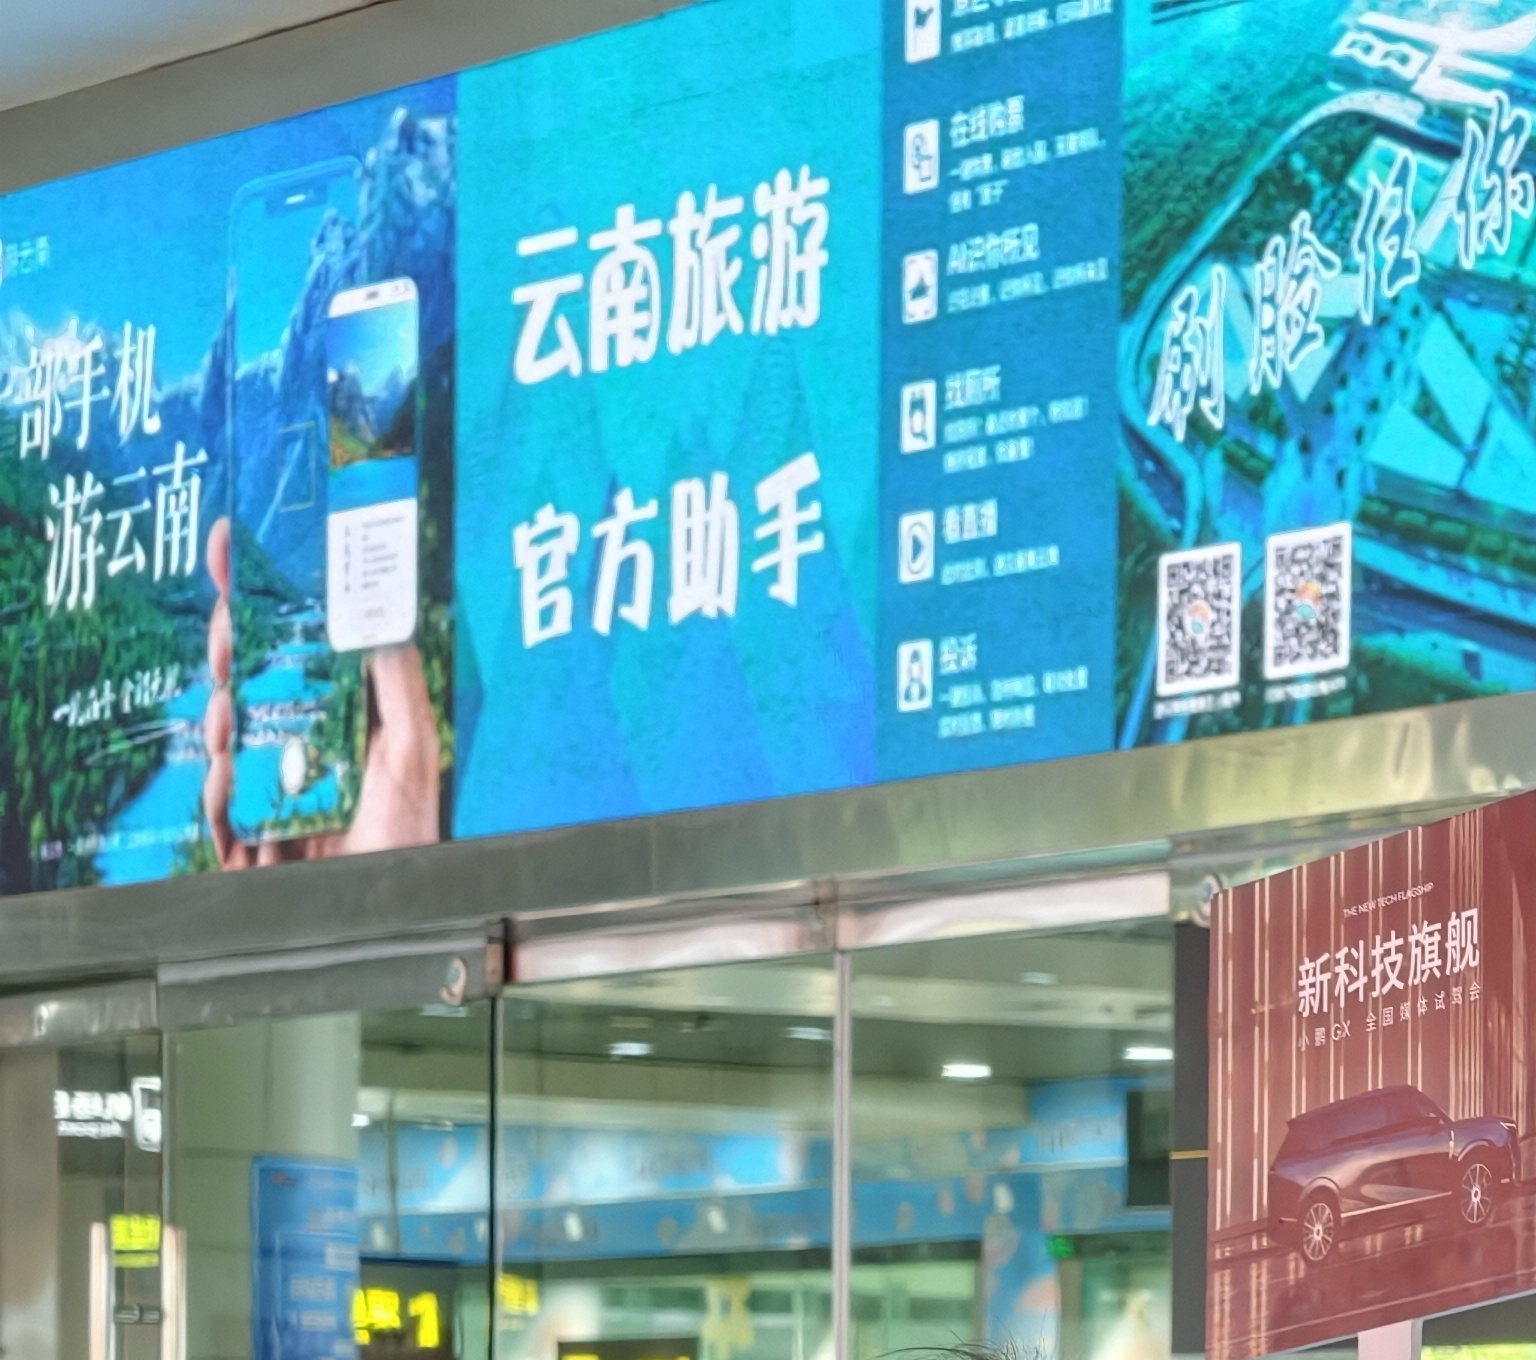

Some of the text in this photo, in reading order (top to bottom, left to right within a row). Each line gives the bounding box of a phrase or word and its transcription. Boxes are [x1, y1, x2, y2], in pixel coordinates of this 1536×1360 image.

[511, 164, 830, 385] 云南旅游
[0, 317, 162, 461] 部手机
[44, 440, 208, 618] 游云南
[511, 451, 824, 649] 官方助手
[1297, 907, 1480, 1019] 新科技旗舰
[1343, 907, 1358, 919] THE
[1358, 900, 1376, 914] NEW
[1377, 894, 1397, 908] TECH
